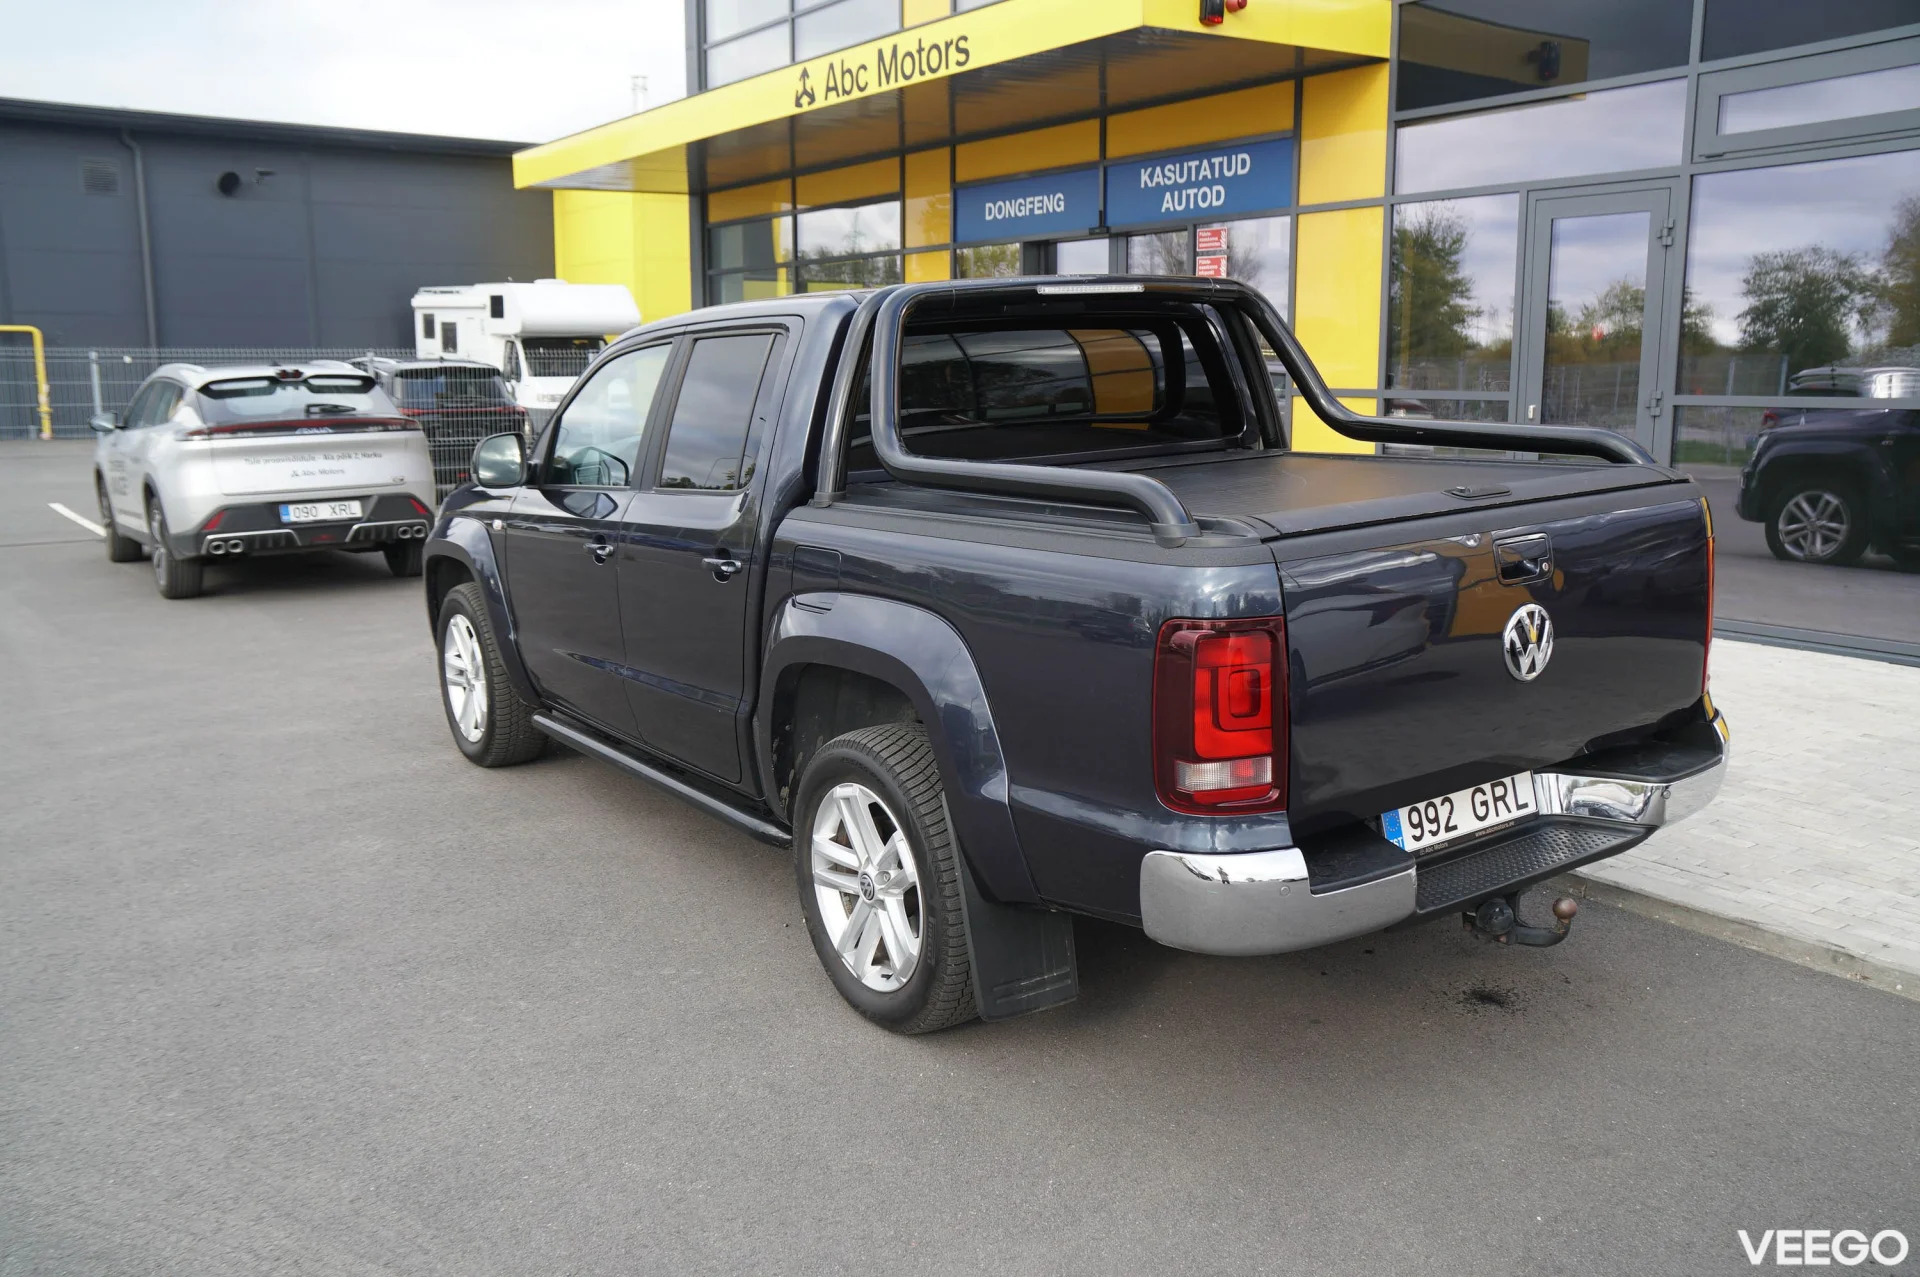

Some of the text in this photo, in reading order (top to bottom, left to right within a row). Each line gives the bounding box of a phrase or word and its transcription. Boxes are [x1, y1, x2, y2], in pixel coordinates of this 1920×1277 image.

[825, 35, 970, 101] Abc Motors
[1140, 153, 1251, 189] KASUTATUD
[985, 192, 1065, 221] DONGFENG
[1161, 185, 1225, 213] AUTOD
[328, 503, 357, 517] XRL
[1407, 776, 1529, 842] 992 GRL
